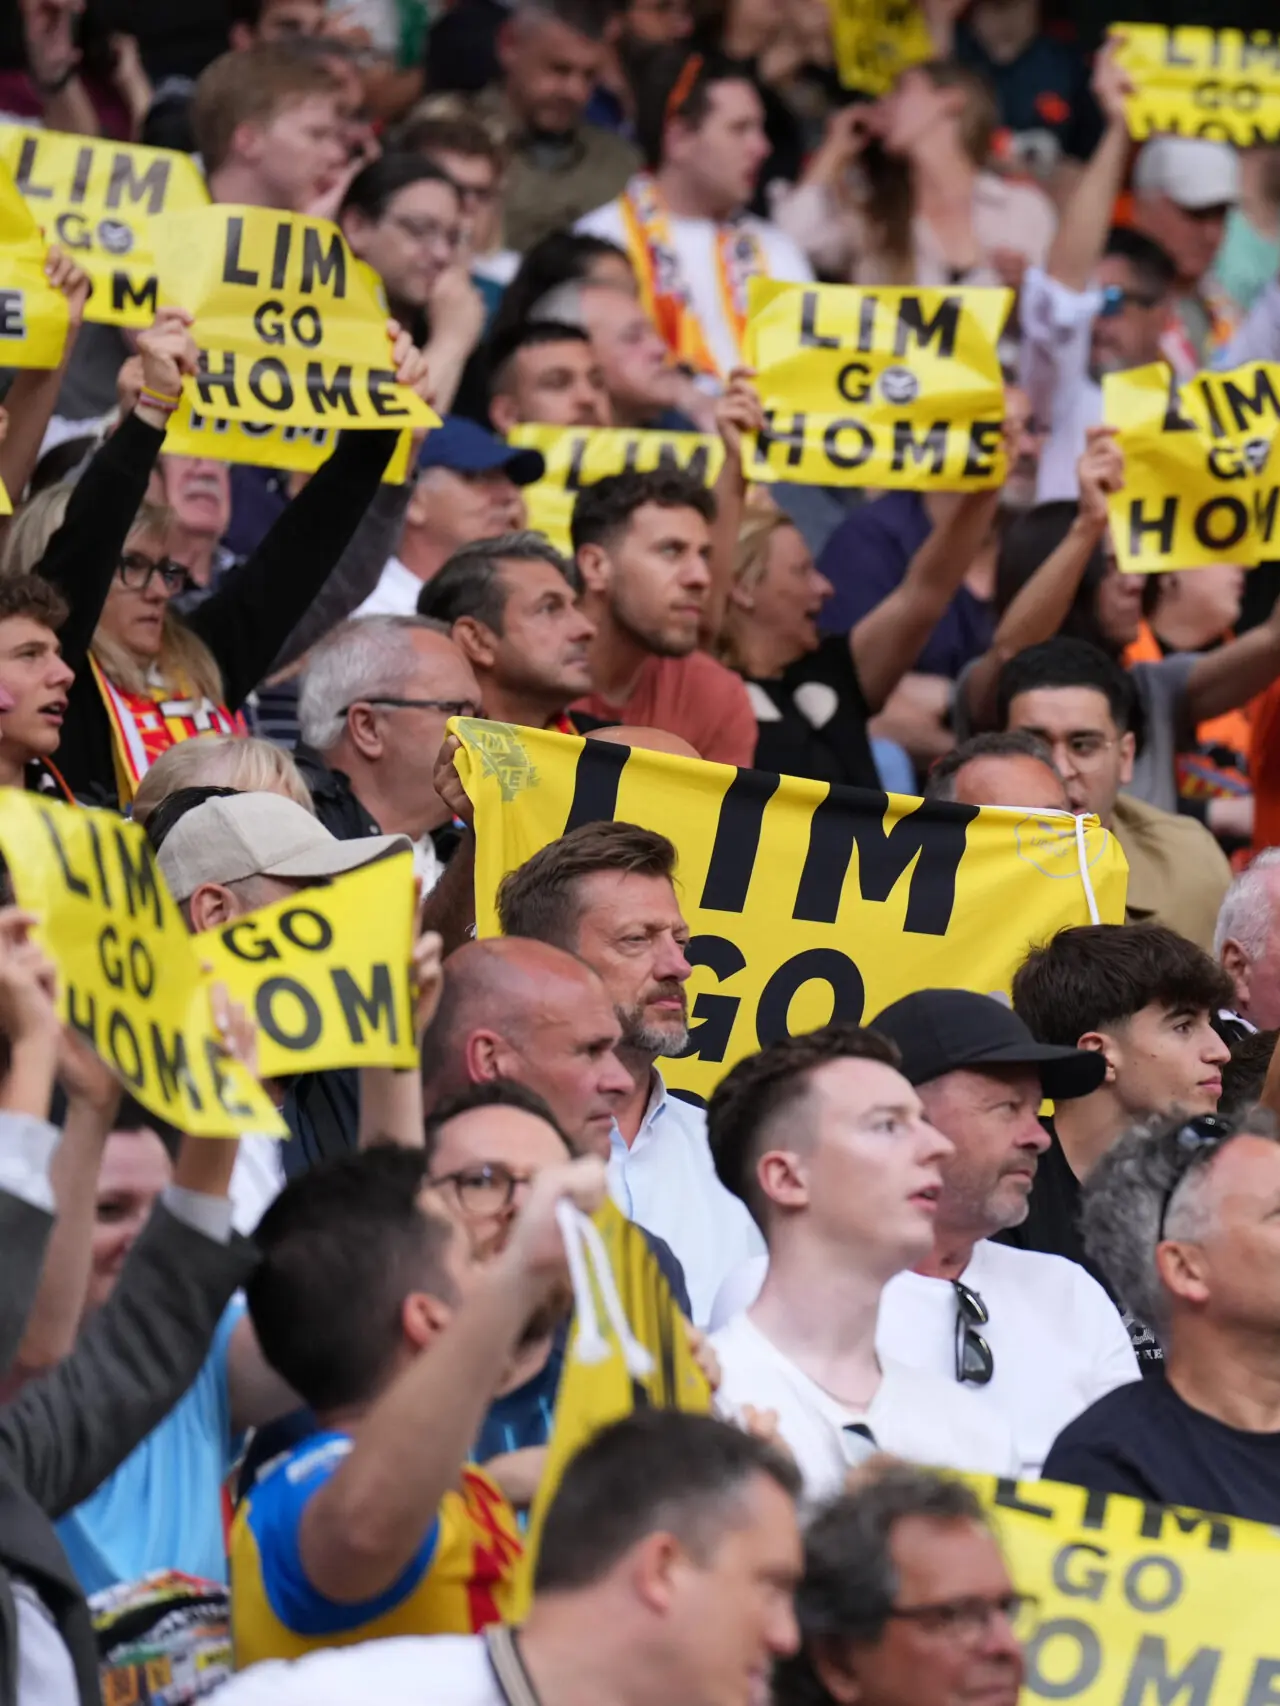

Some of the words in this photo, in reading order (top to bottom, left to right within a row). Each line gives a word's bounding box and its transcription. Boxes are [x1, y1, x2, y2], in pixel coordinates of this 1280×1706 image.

[1194, 81, 1260, 114] GO
[16, 137, 171, 214] LIM
[222, 216, 346, 298] LIM
[254, 300, 323, 348] GO
[798, 291, 963, 359] LIM
[195, 350, 411, 417] HOME
[753, 410, 1002, 477] HOME
[39, 805, 164, 931] LIM
[99, 923, 156, 999] GO
[220, 906, 334, 962] GO
[254, 962, 415, 1052] OM
[676, 934, 866, 1063] GO
[67, 983, 256, 1117] HOME
[1052, 1541, 1184, 1615] GO
